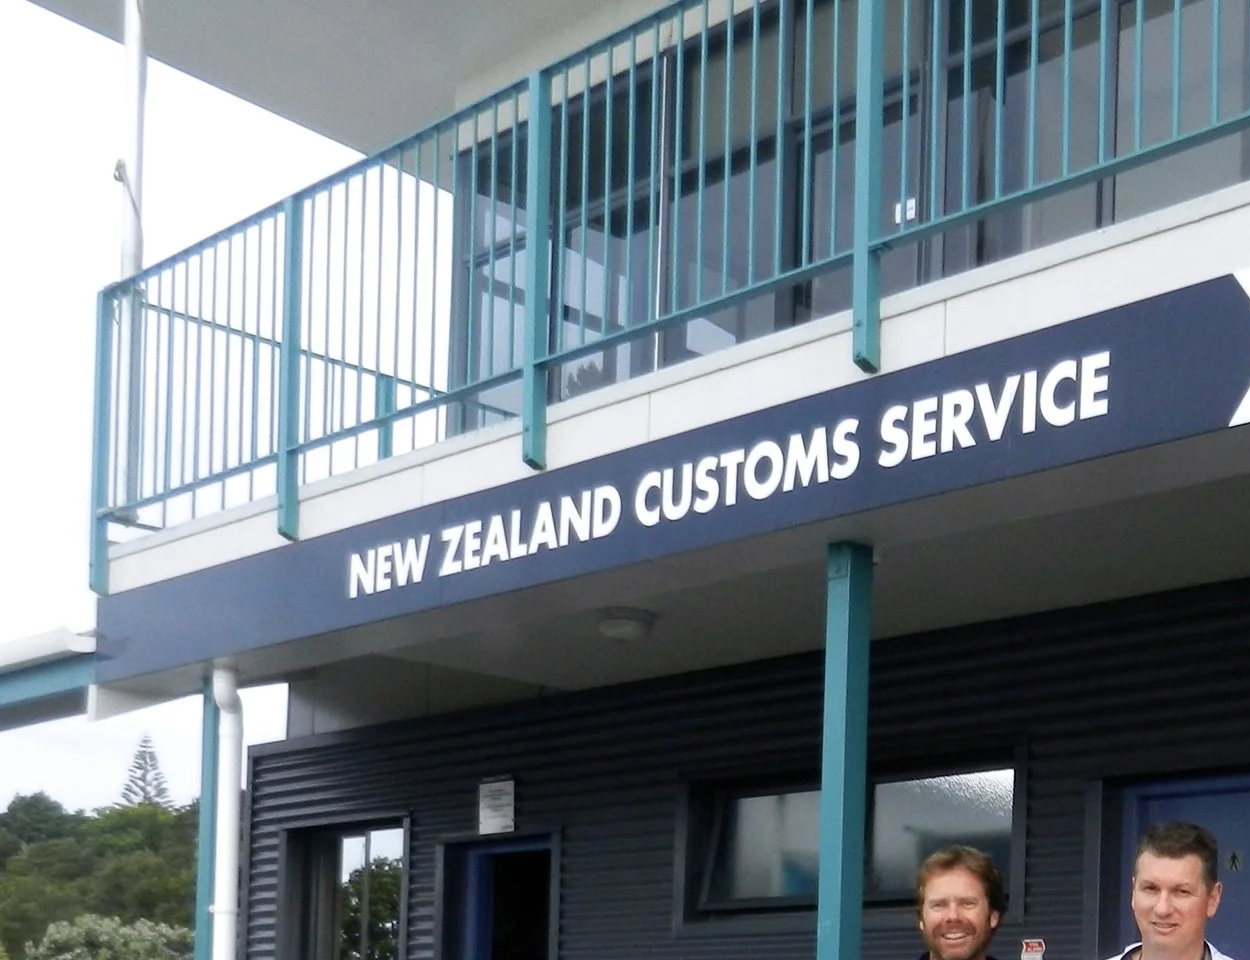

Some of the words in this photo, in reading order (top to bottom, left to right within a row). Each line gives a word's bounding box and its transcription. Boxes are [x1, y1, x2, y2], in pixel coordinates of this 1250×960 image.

[348, 536, 430, 598] NEW
[438, 485, 621, 577] ZEALAND
[634, 418, 860, 527] CUSTOMS
[879, 350, 1111, 464] SERVICE
